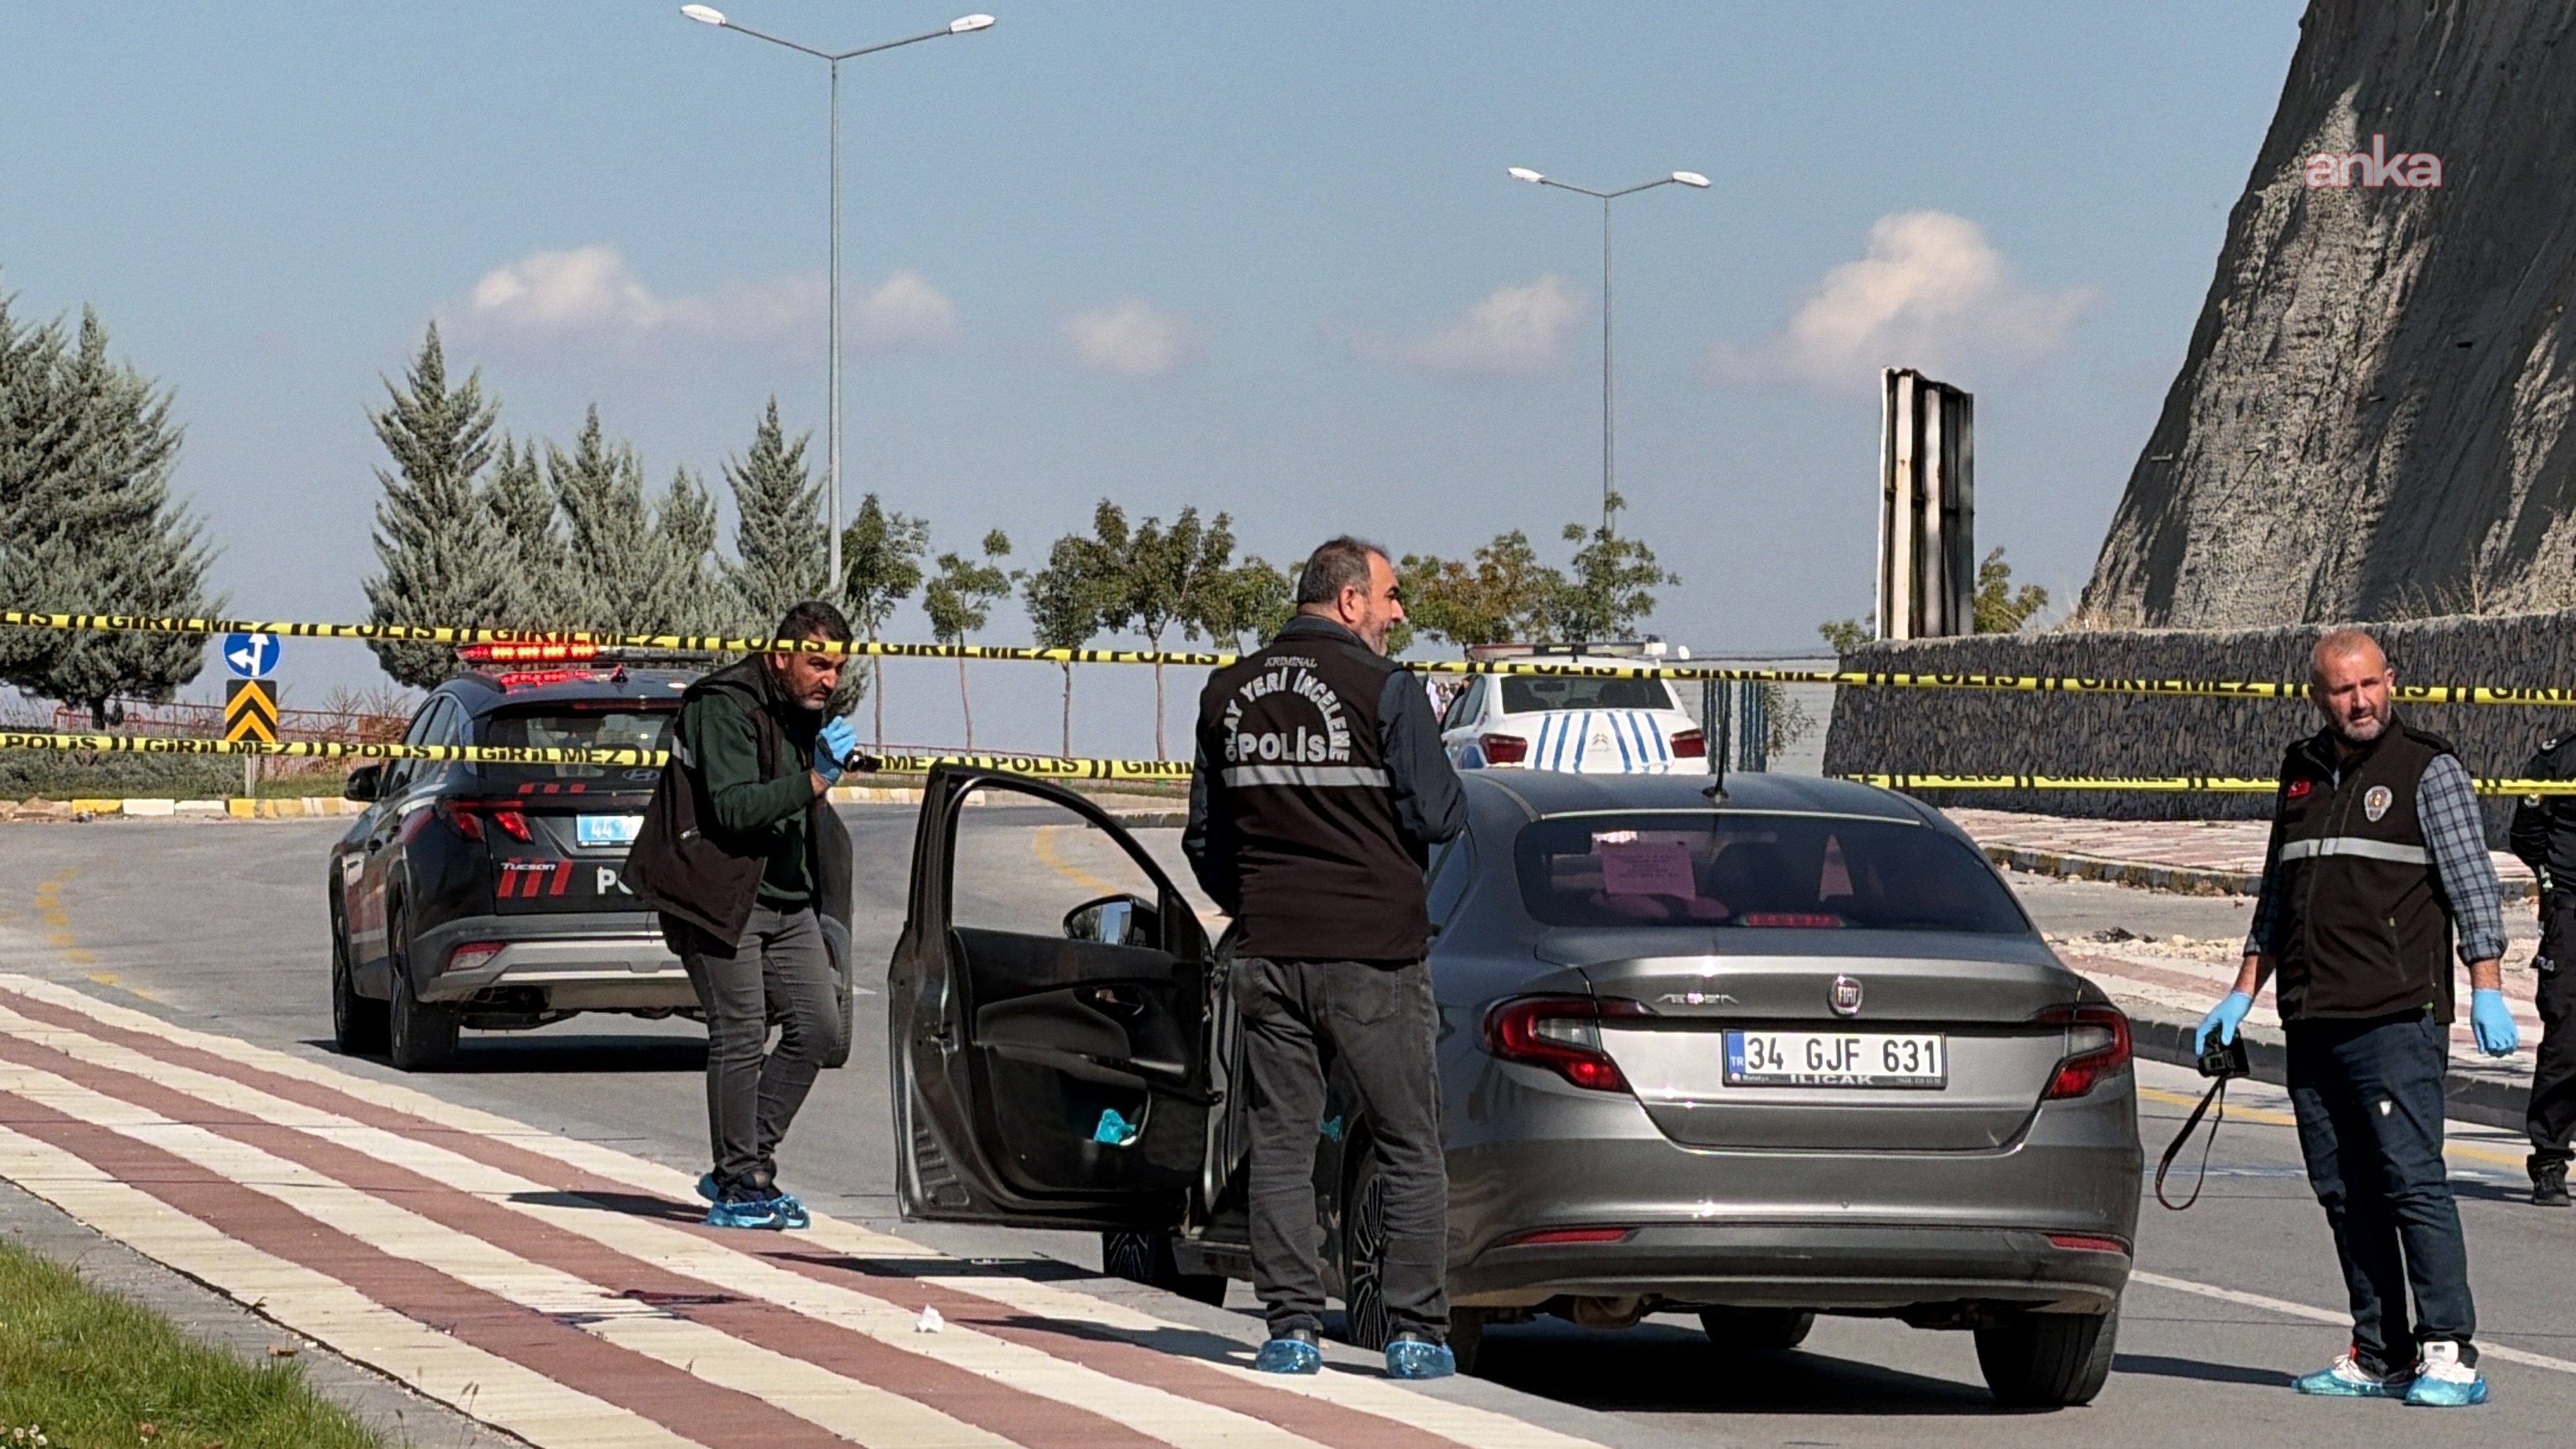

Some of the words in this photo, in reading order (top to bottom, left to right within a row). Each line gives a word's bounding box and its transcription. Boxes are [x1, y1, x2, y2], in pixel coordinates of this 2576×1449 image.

[1838, 986, 1858, 1004] FIAT
[1730, 1056, 1744, 1066] TR
[1748, 1036, 1784, 1071] 34
[1805, 1038, 1861, 1071] GJF
[1882, 1039, 1936, 1074] 631
